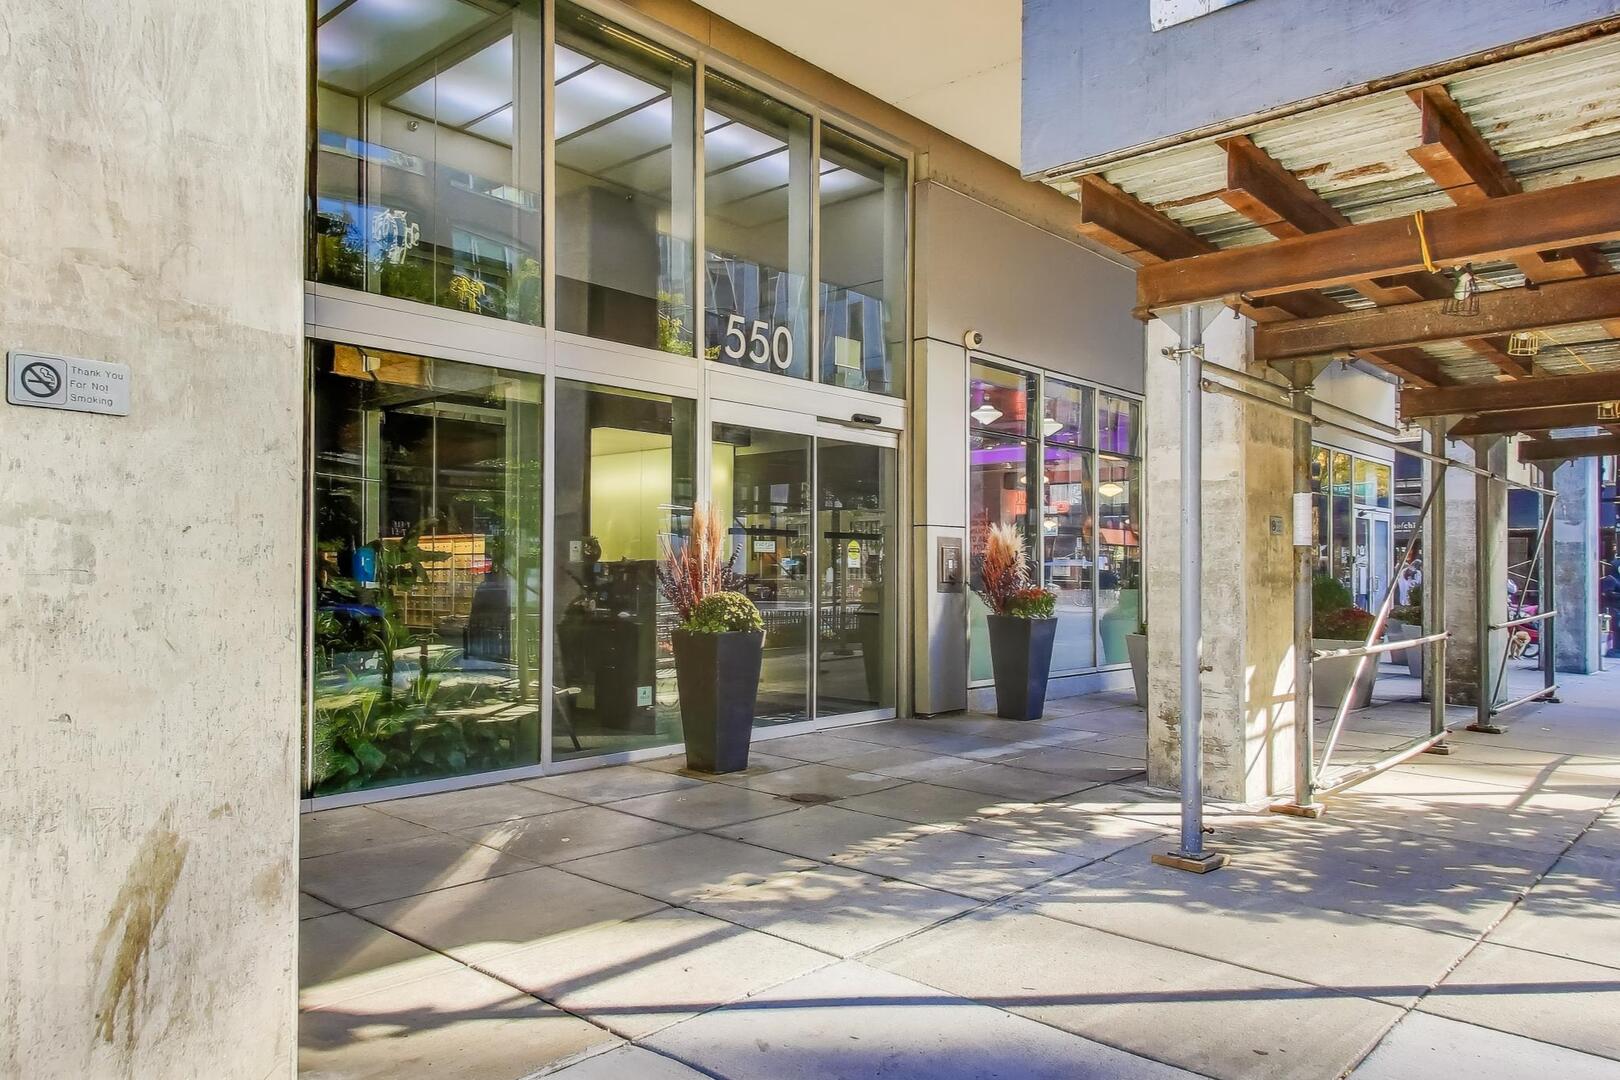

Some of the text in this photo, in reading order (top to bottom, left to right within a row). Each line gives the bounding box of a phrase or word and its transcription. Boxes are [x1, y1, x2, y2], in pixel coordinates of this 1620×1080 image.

[724, 313, 793, 369] 550
[70, 365, 125, 381] Thank You
[70, 380, 109, 392] For Not
[70, 393, 114, 407] Smoking
